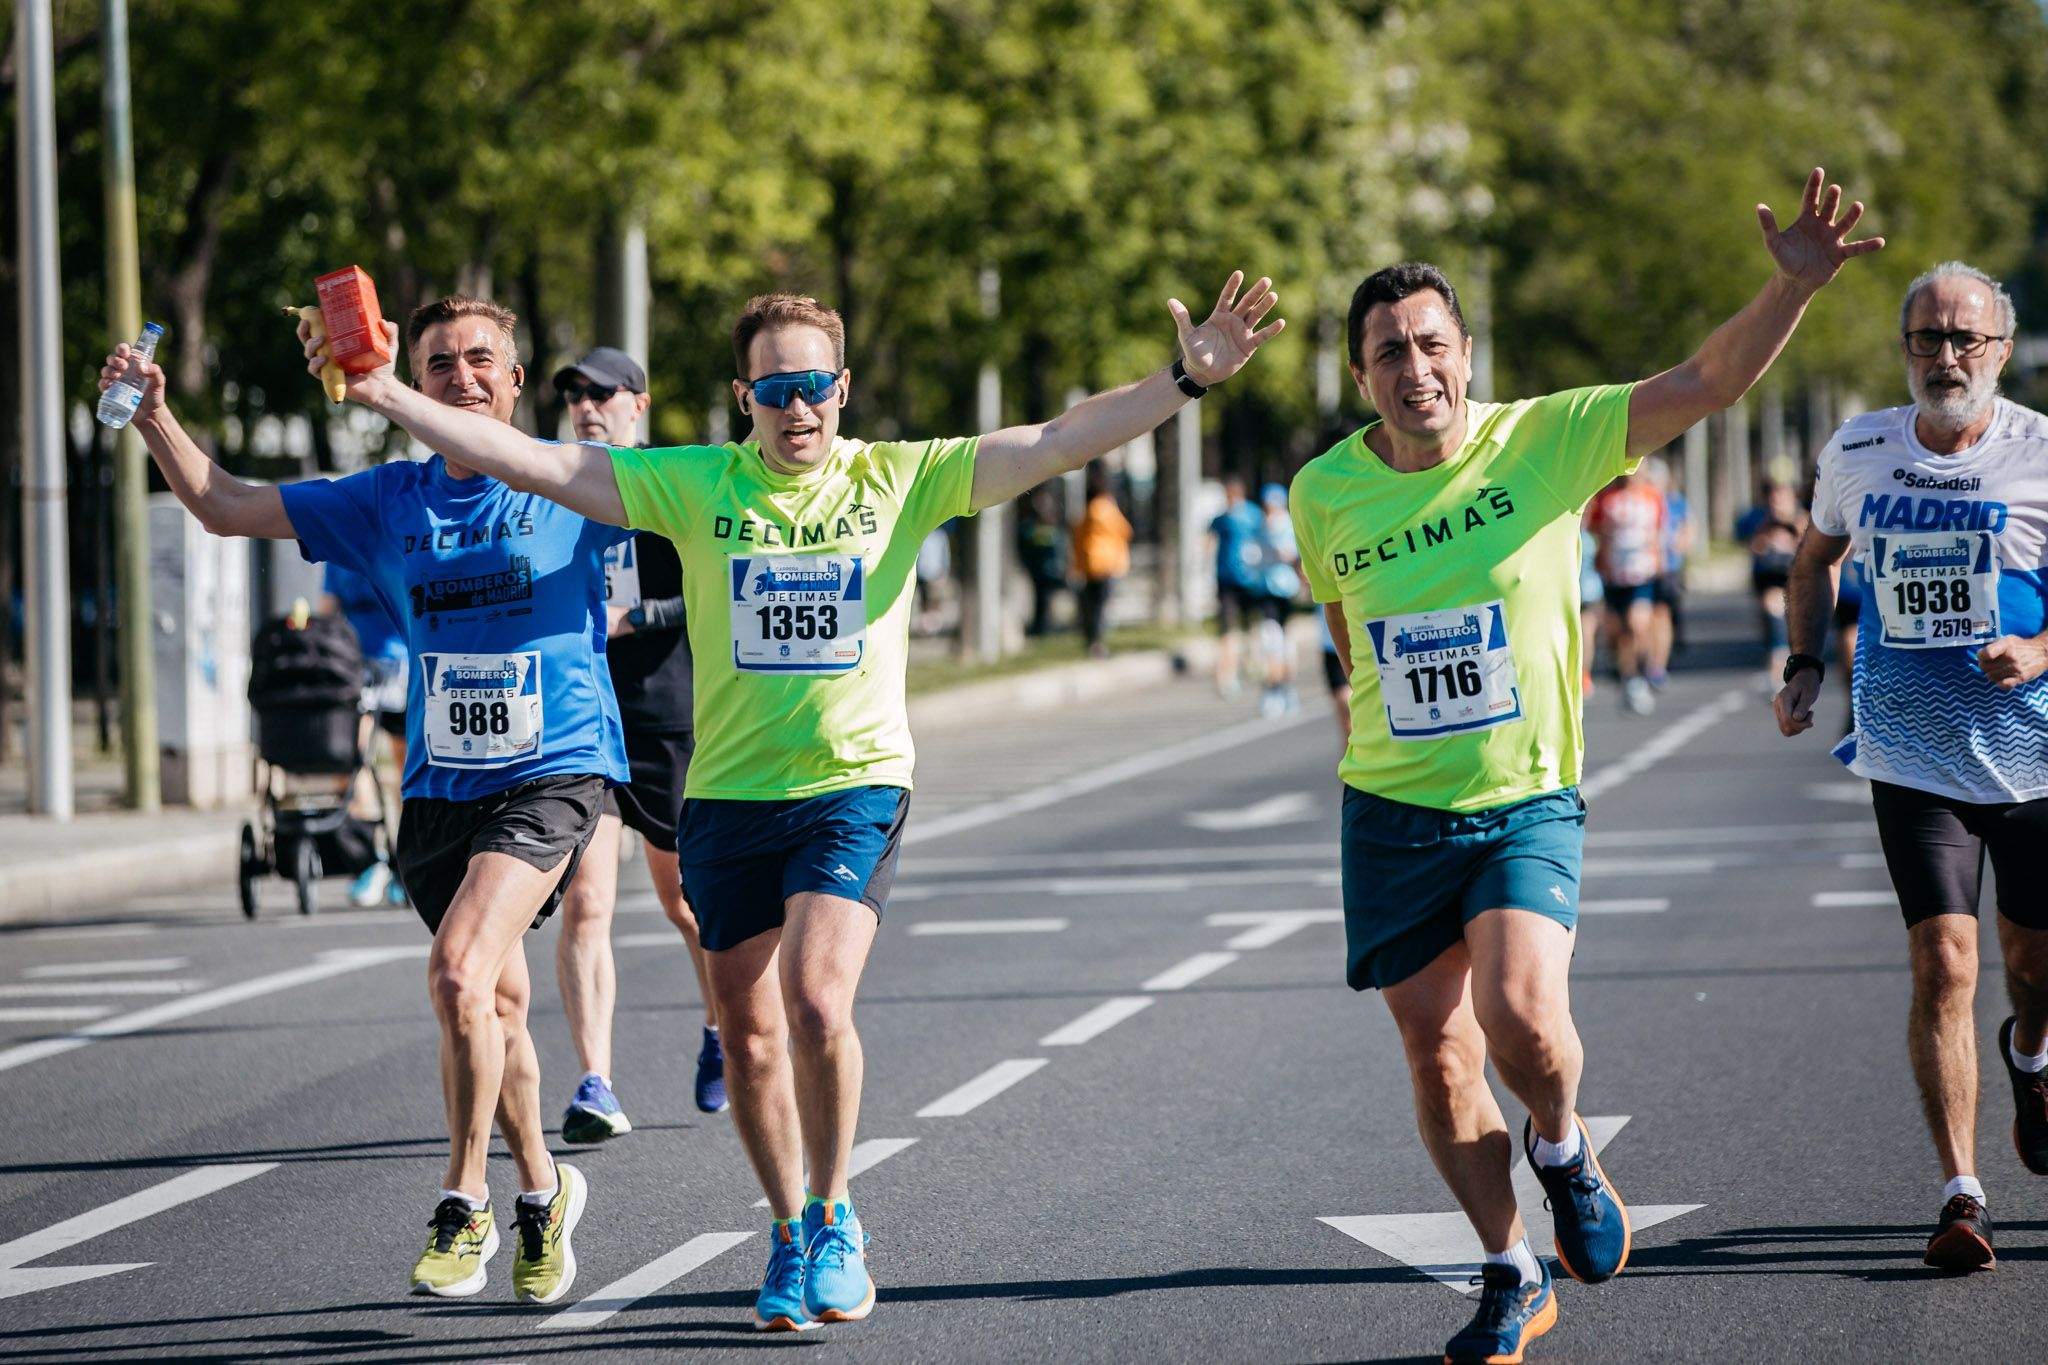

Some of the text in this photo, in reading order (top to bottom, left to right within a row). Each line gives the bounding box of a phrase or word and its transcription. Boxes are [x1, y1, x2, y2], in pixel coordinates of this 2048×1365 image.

[1904, 476, 1981, 492] Sabadell
[1859, 493, 2008, 535] MADRID
[403, 517, 534, 554] DECIMAS
[714, 511, 878, 548] DECIMAS
[1334, 491, 1515, 577] DECIMAS
[1906, 547, 1968, 559] BOMBEROS
[434, 571, 528, 594] BOMBEROS
[775, 572, 838, 582] BOMBEROS
[1902, 567, 1968, 579] DECIMAS
[471, 583, 529, 605] de MADRID
[767, 592, 837, 602] DECIMAS
[1893, 579, 1971, 616] 1938
[756, 605, 839, 640] 1353
[1932, 618, 1972, 638] 2579
[1411, 625, 1478, 642] BOMBEROS
[1407, 645, 1480, 665] DECIMAS
[456, 670, 515, 680] BOMBEROS
[1405, 660, 1483, 704] 1716
[450, 688, 515, 699] DECIMAS
[449, 701, 510, 736] 988
